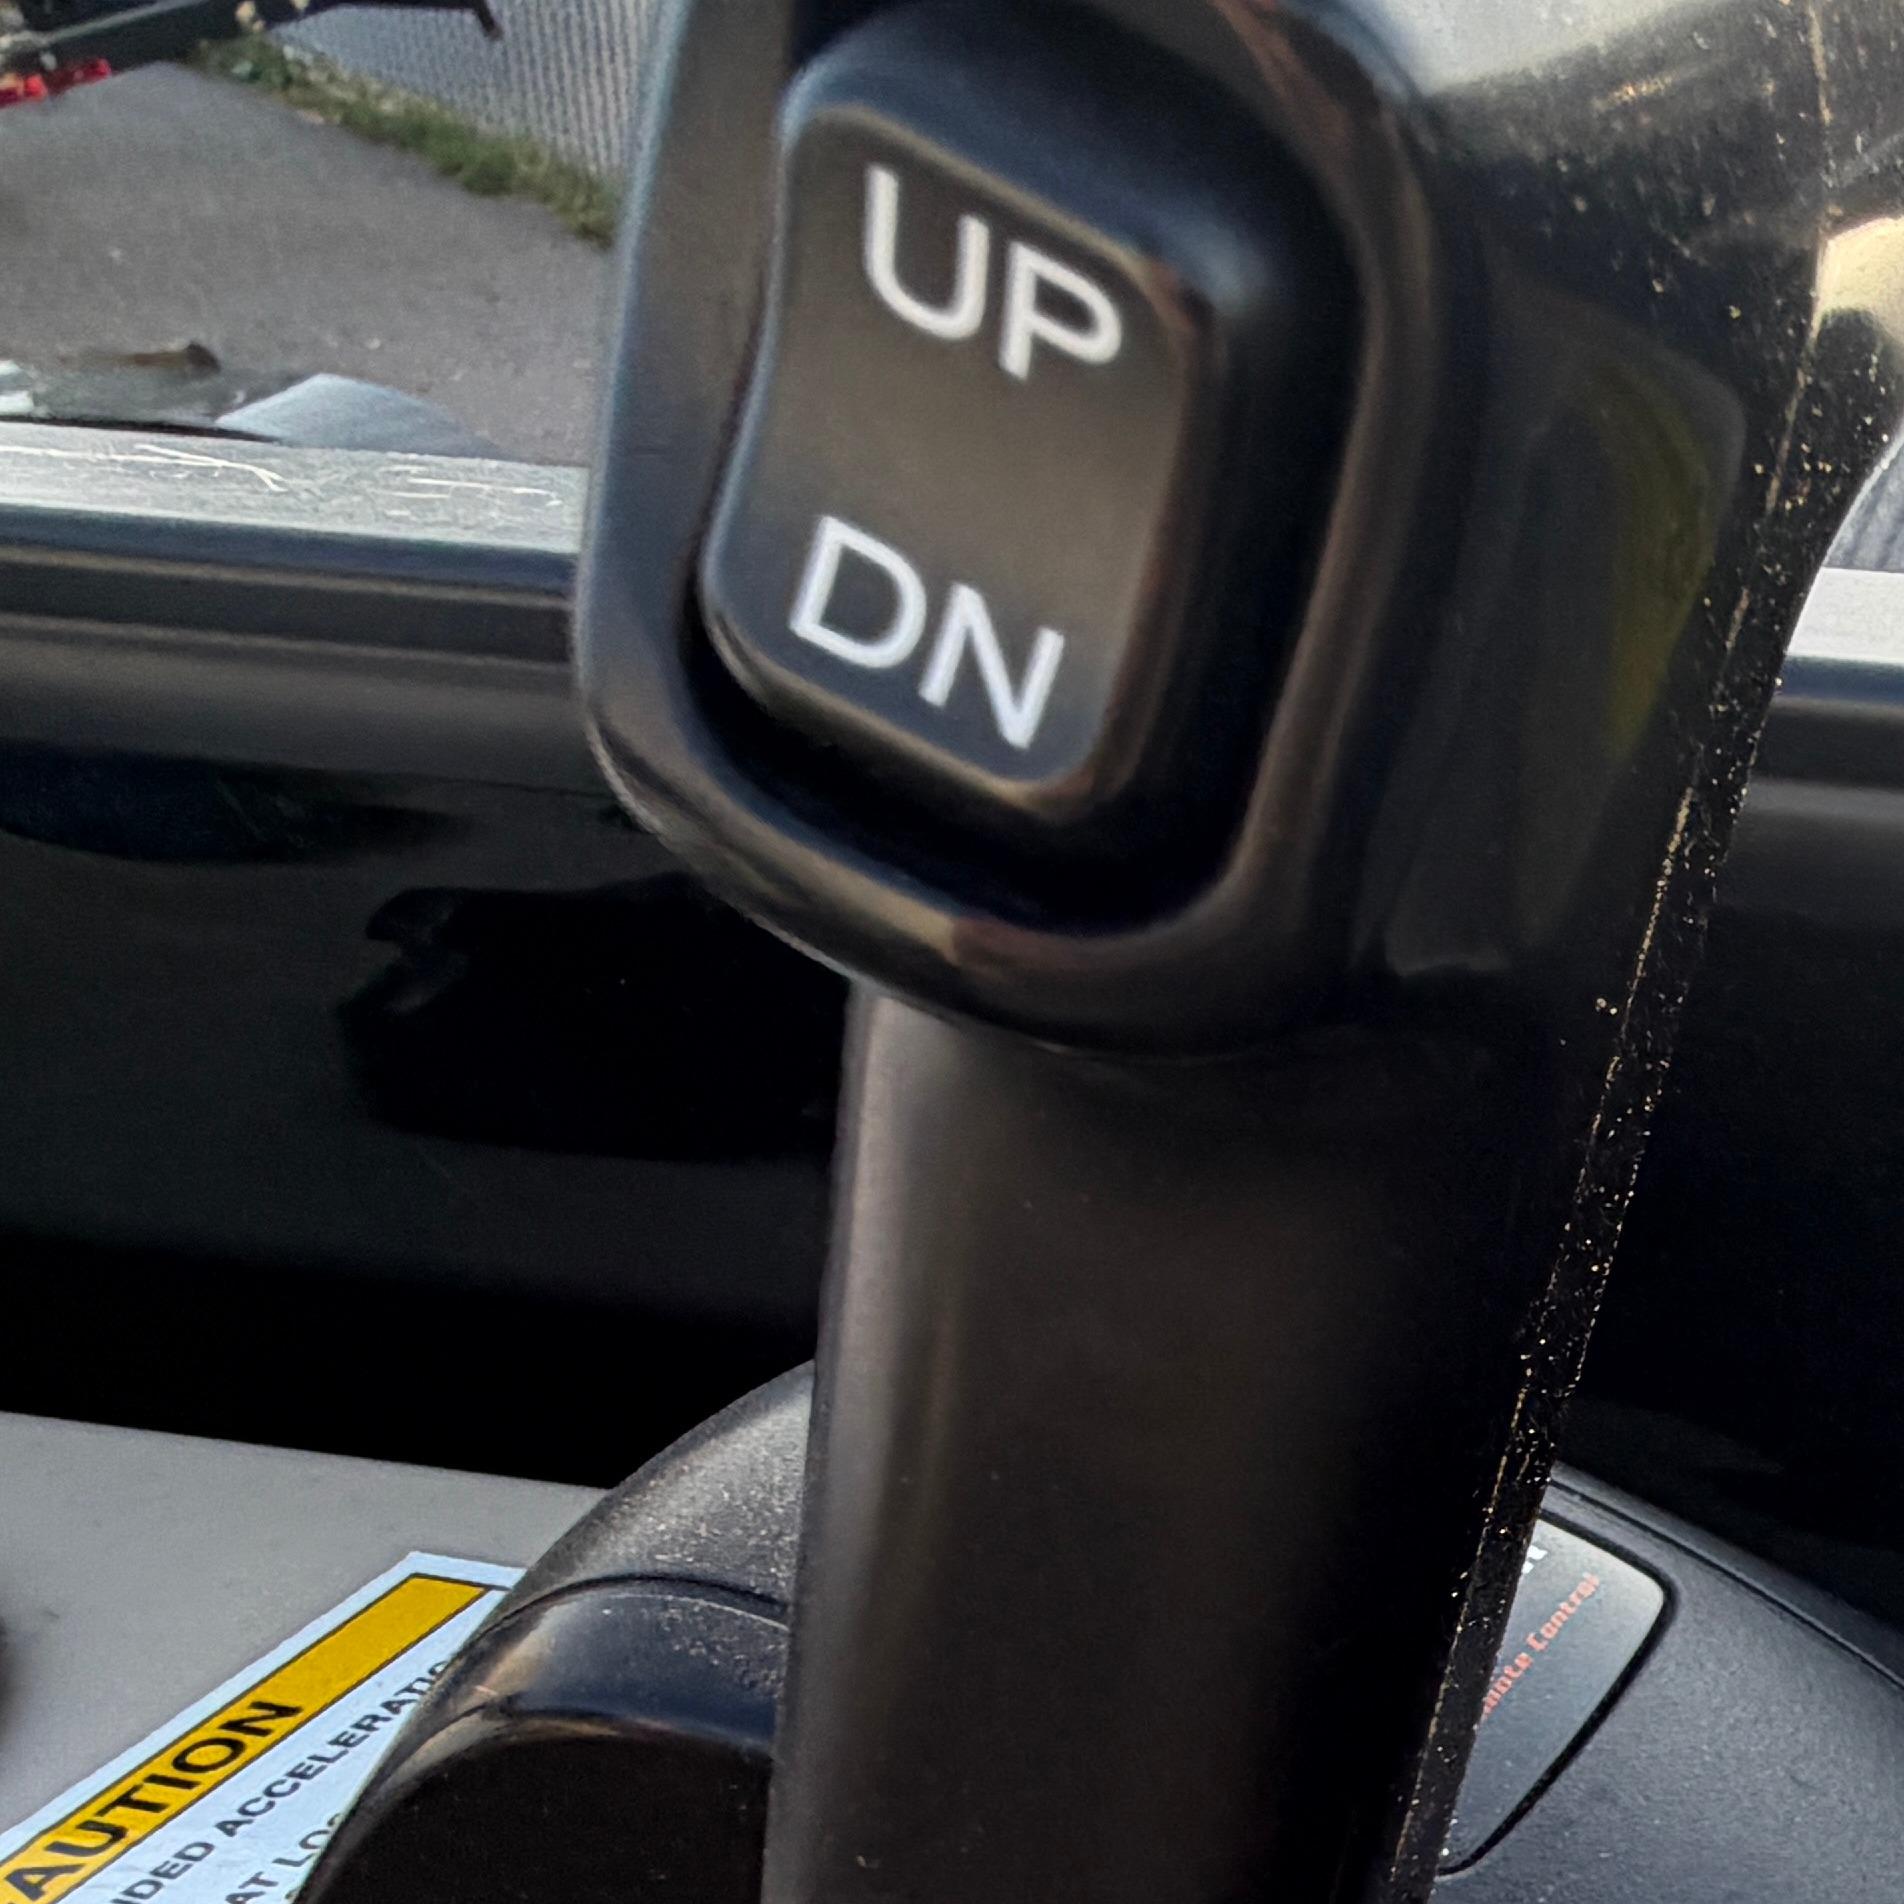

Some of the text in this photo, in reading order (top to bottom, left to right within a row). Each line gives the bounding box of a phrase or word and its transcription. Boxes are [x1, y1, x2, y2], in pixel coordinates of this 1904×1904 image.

[863, 163, 1123, 380] UP
[788, 515, 1064, 751] DN
[1526, 1571, 1600, 1651] Control
